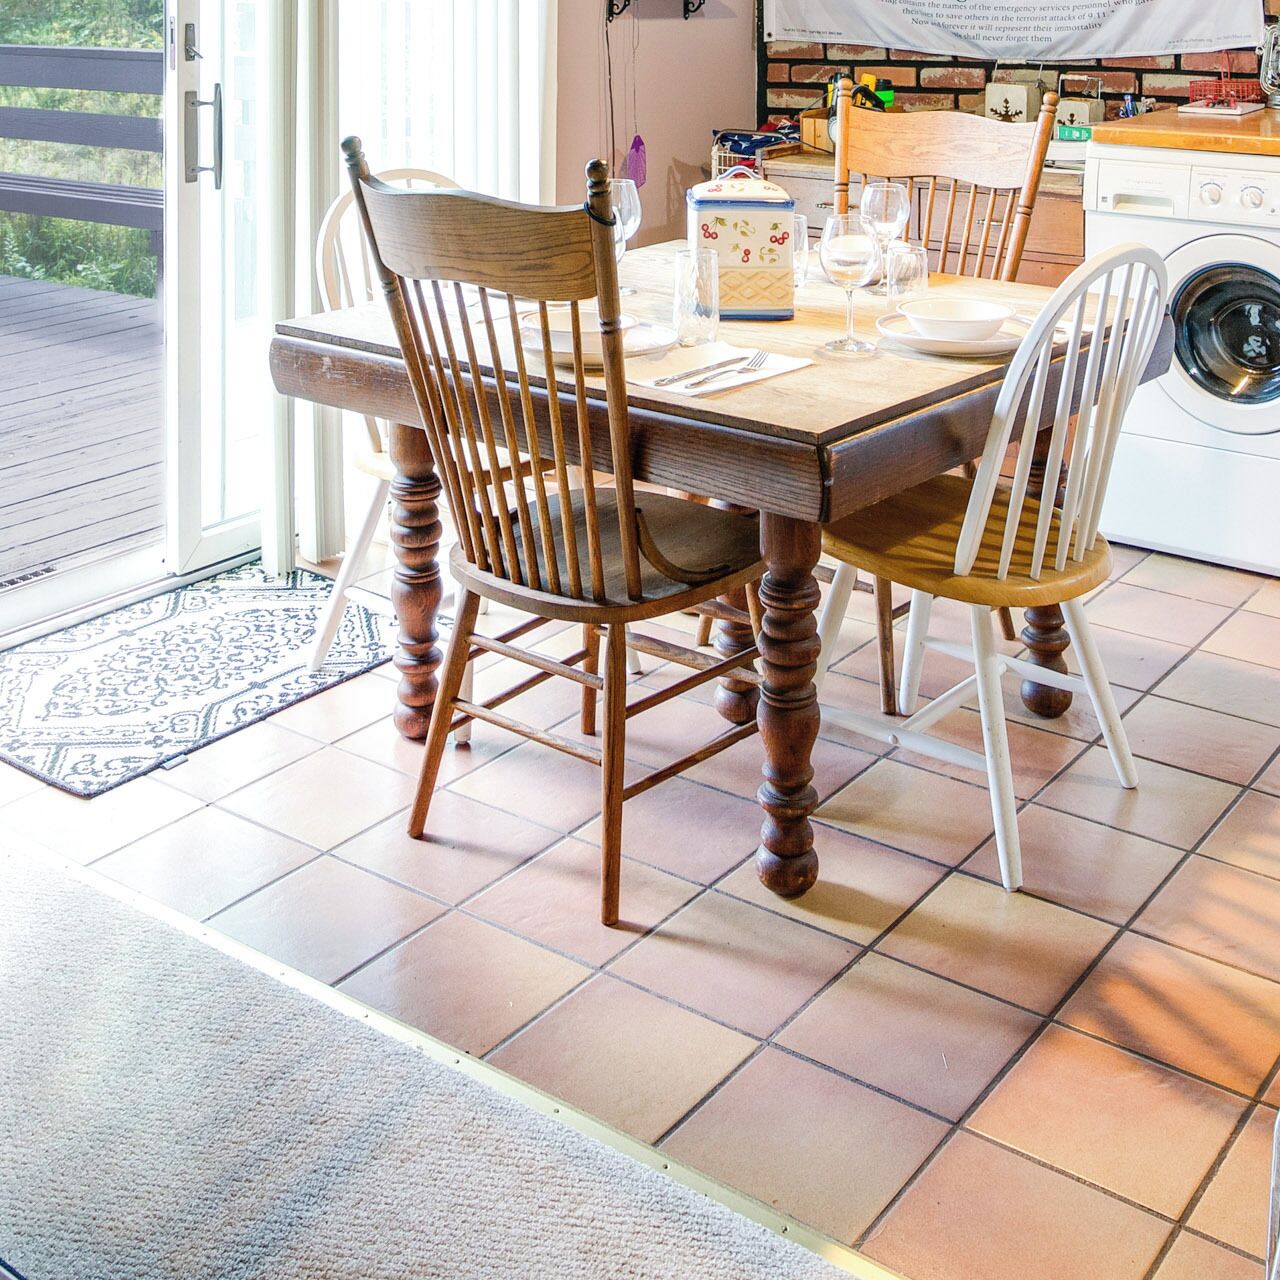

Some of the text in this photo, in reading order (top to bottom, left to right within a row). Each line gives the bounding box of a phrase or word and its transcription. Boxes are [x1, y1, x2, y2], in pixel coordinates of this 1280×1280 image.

[927, 1, 941, 9] the
[968, 2, 978, 10] of
[978, 3, 992, 11] the
[993, 5, 1037, 13] emergency
[1072, 0, 1111, 12] personnel
[935, 11, 944, 19] to
[964, 13, 989, 21] others
[1001, 14, 1014, 22] the
[1016, 14, 1047, 22] terrorist
[1048, 13, 1076, 21] attacks
[1077, 12, 1086, 20] of
[939, 22, 968, 30] forever
[978, 23, 993, 31] will
[995, 24, 1032, 32] represent
[1033, 23, 1052, 32] their
[1054, 21, 1103, 32] immortality
[962, 32, 981, 41] shall
[1005, 34, 1029, 43] forget
[1031, 34, 1052, 42] them
